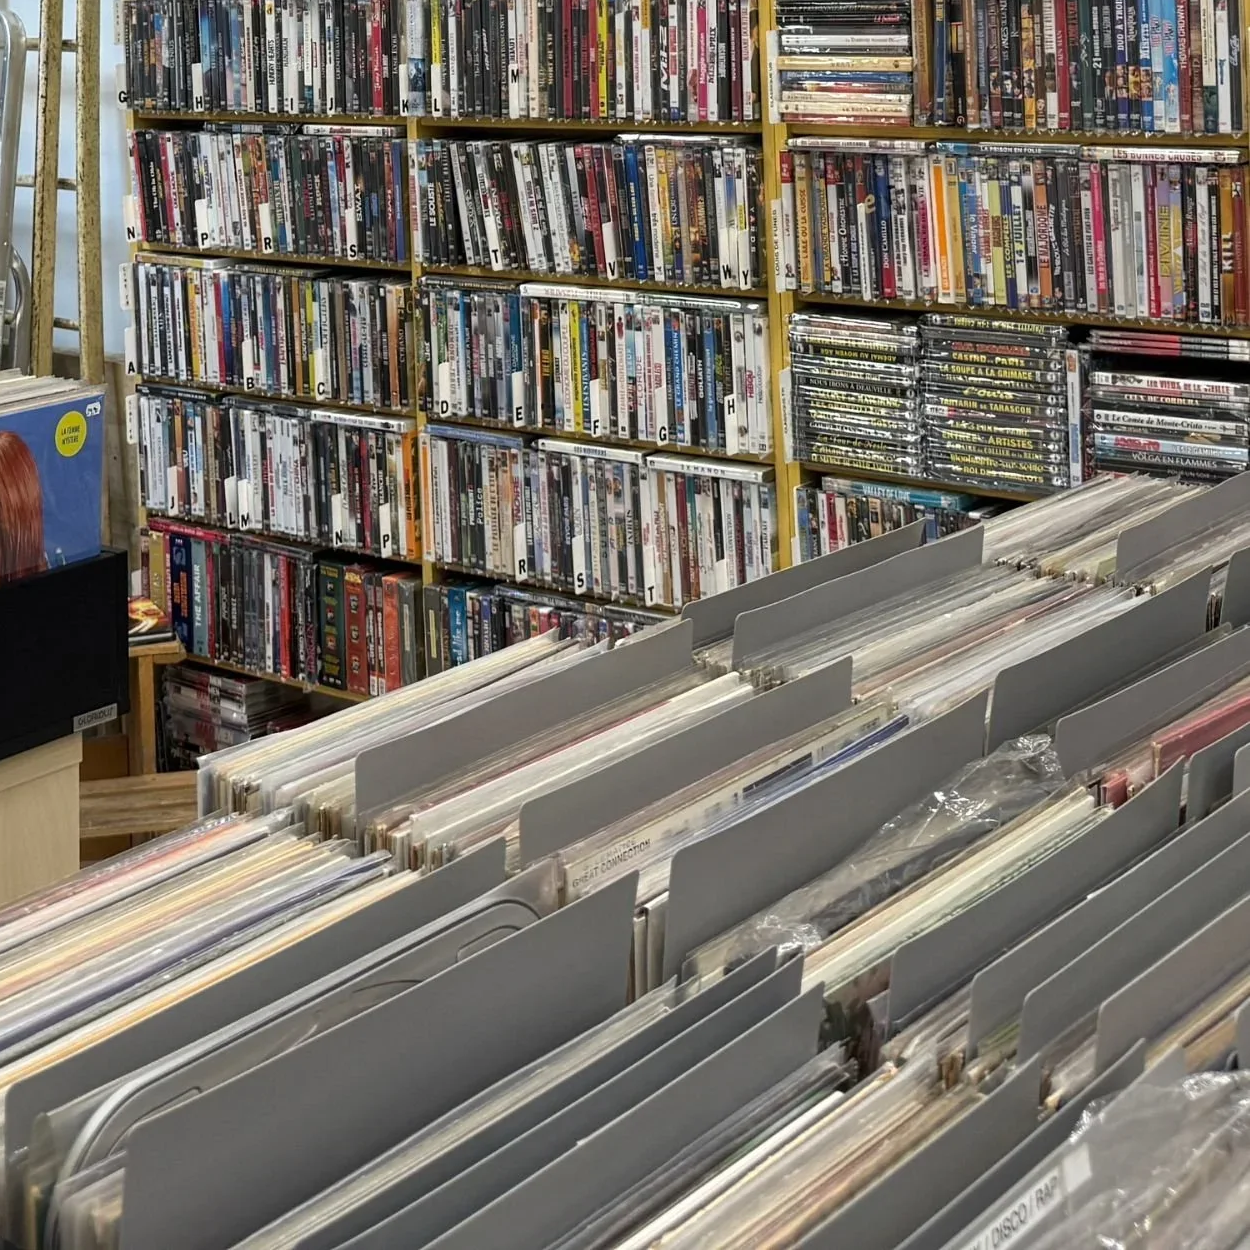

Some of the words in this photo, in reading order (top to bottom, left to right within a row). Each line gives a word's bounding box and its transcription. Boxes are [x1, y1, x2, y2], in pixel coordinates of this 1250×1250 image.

[1176, 4, 1187, 37] CROWN
[1177, 37, 1188, 70] THOMAS
[510, 67, 519, 84] M
[118, 90, 128, 103] G
[328, 98, 334, 112] J
[264, 236, 273, 251] R
[1158, 205, 1171, 278] DIVINE
[1221, 231, 1234, 271] KILL
[608, 261, 616, 277] V
[126, 360, 137, 376] A
[440, 400, 449, 416] D
[658, 425, 668, 442] G
[988, 436, 1033, 450] ARTISTES
[1168, 455, 1218, 469] FLAMMES
[228, 511, 236, 526] L
[382, 533, 391, 549] P
[194, 564, 202, 602] AFFAIR
[647, 586, 656, 602] T
[193, 603, 202, 628] THE
[76, 706, 116, 729] GLORIOUS
[571, 865, 599, 889] GREAT
[600, 838, 652, 874] CONNECTION
